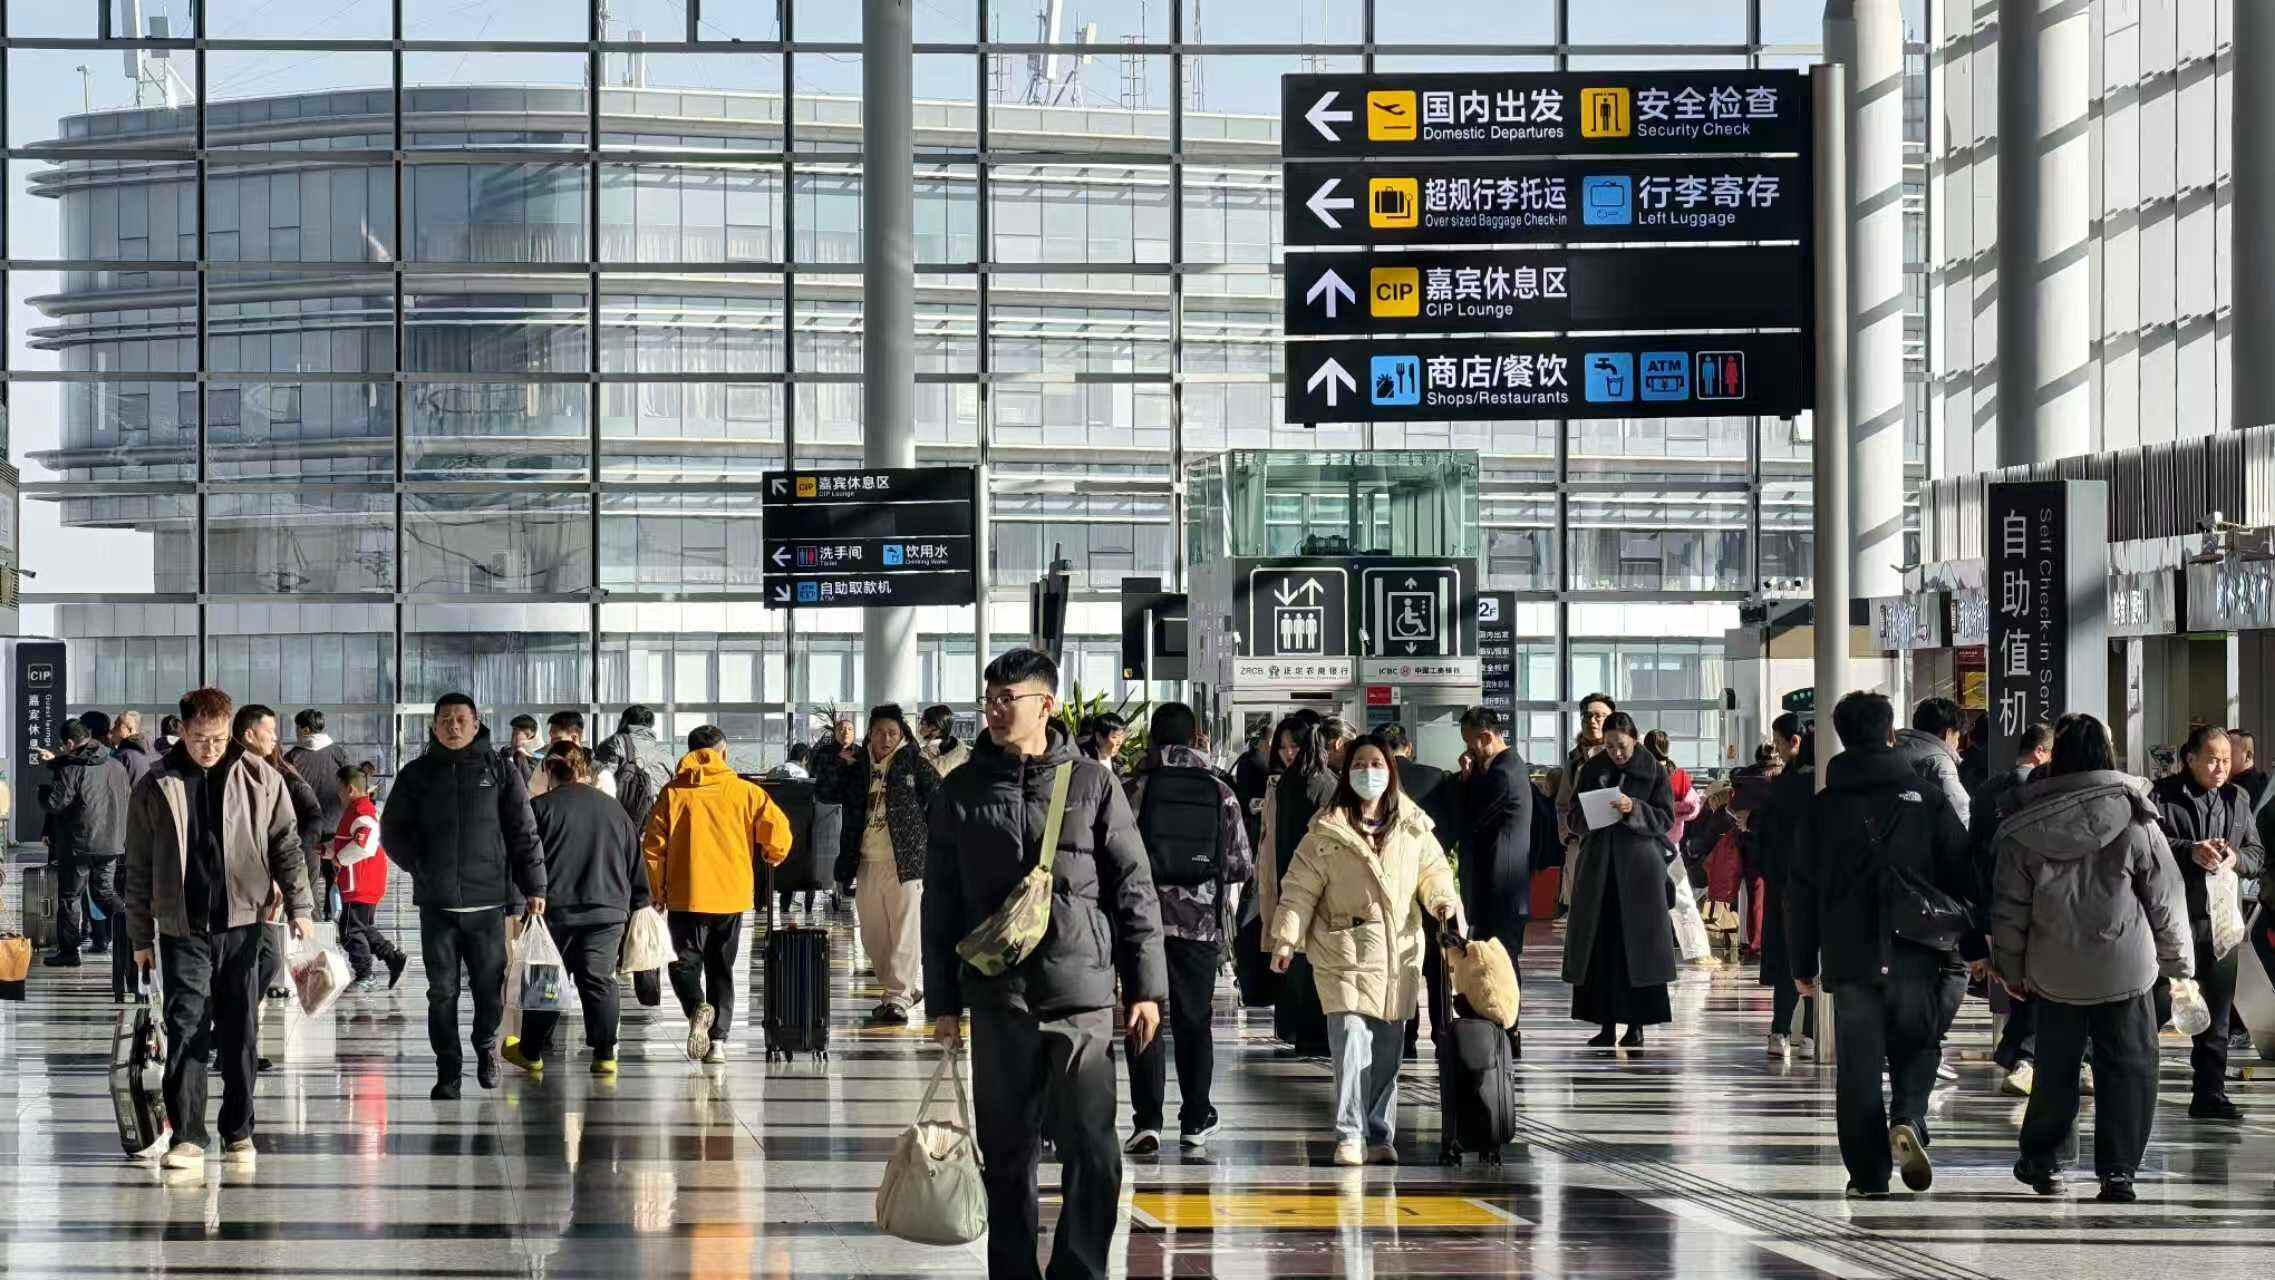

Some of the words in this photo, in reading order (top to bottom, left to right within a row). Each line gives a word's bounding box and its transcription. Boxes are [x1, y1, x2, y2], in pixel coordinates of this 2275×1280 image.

[1423, 88, 1564, 124] 国内出发
[1637, 85, 1778, 120] 安全检查
[1423, 126, 1485, 140] Domestic
[1490, 126, 1564, 141] Departures
[1637, 123, 1699, 139] Security
[1703, 122, 1751, 136] Check
[1425, 176, 1567, 211] 超规行李托运
[1639, 173, 1780, 209] 行李寄存
[1479, 213, 1522, 229] Baggage
[1524, 212, 1567, 226] Check-in
[1638, 211, 1666, 224] Left
[1671, 211, 1736, 227] Luggage
[1426, 266, 1567, 300] 嘉宾休息区
[1376, 283, 1414, 301] CIP
[1426, 303, 1453, 317] CIP
[1458, 302, 1513, 317] Lounge
[1426, 353, 1568, 389] 商店/餐饮
[1648, 359, 1681, 372] ATM
[1426, 390, 1569, 406] Shops/Restaurants
[819, 476, 890, 490] 嘉宾休息区
[2039, 507, 2053, 553] Self
[820, 545, 862, 560] 洗手间
[905, 544, 949, 559] 饮用水
[820, 580, 892, 596] 自助取款机
[1479, 602, 1497, 617] 2F
[2039, 559, 2053, 661] Check-in
[1999, 509, 2032, 737] 自助值机
[30, 670, 51, 681] CIP
[2039, 669, 2053, 721] Serv
